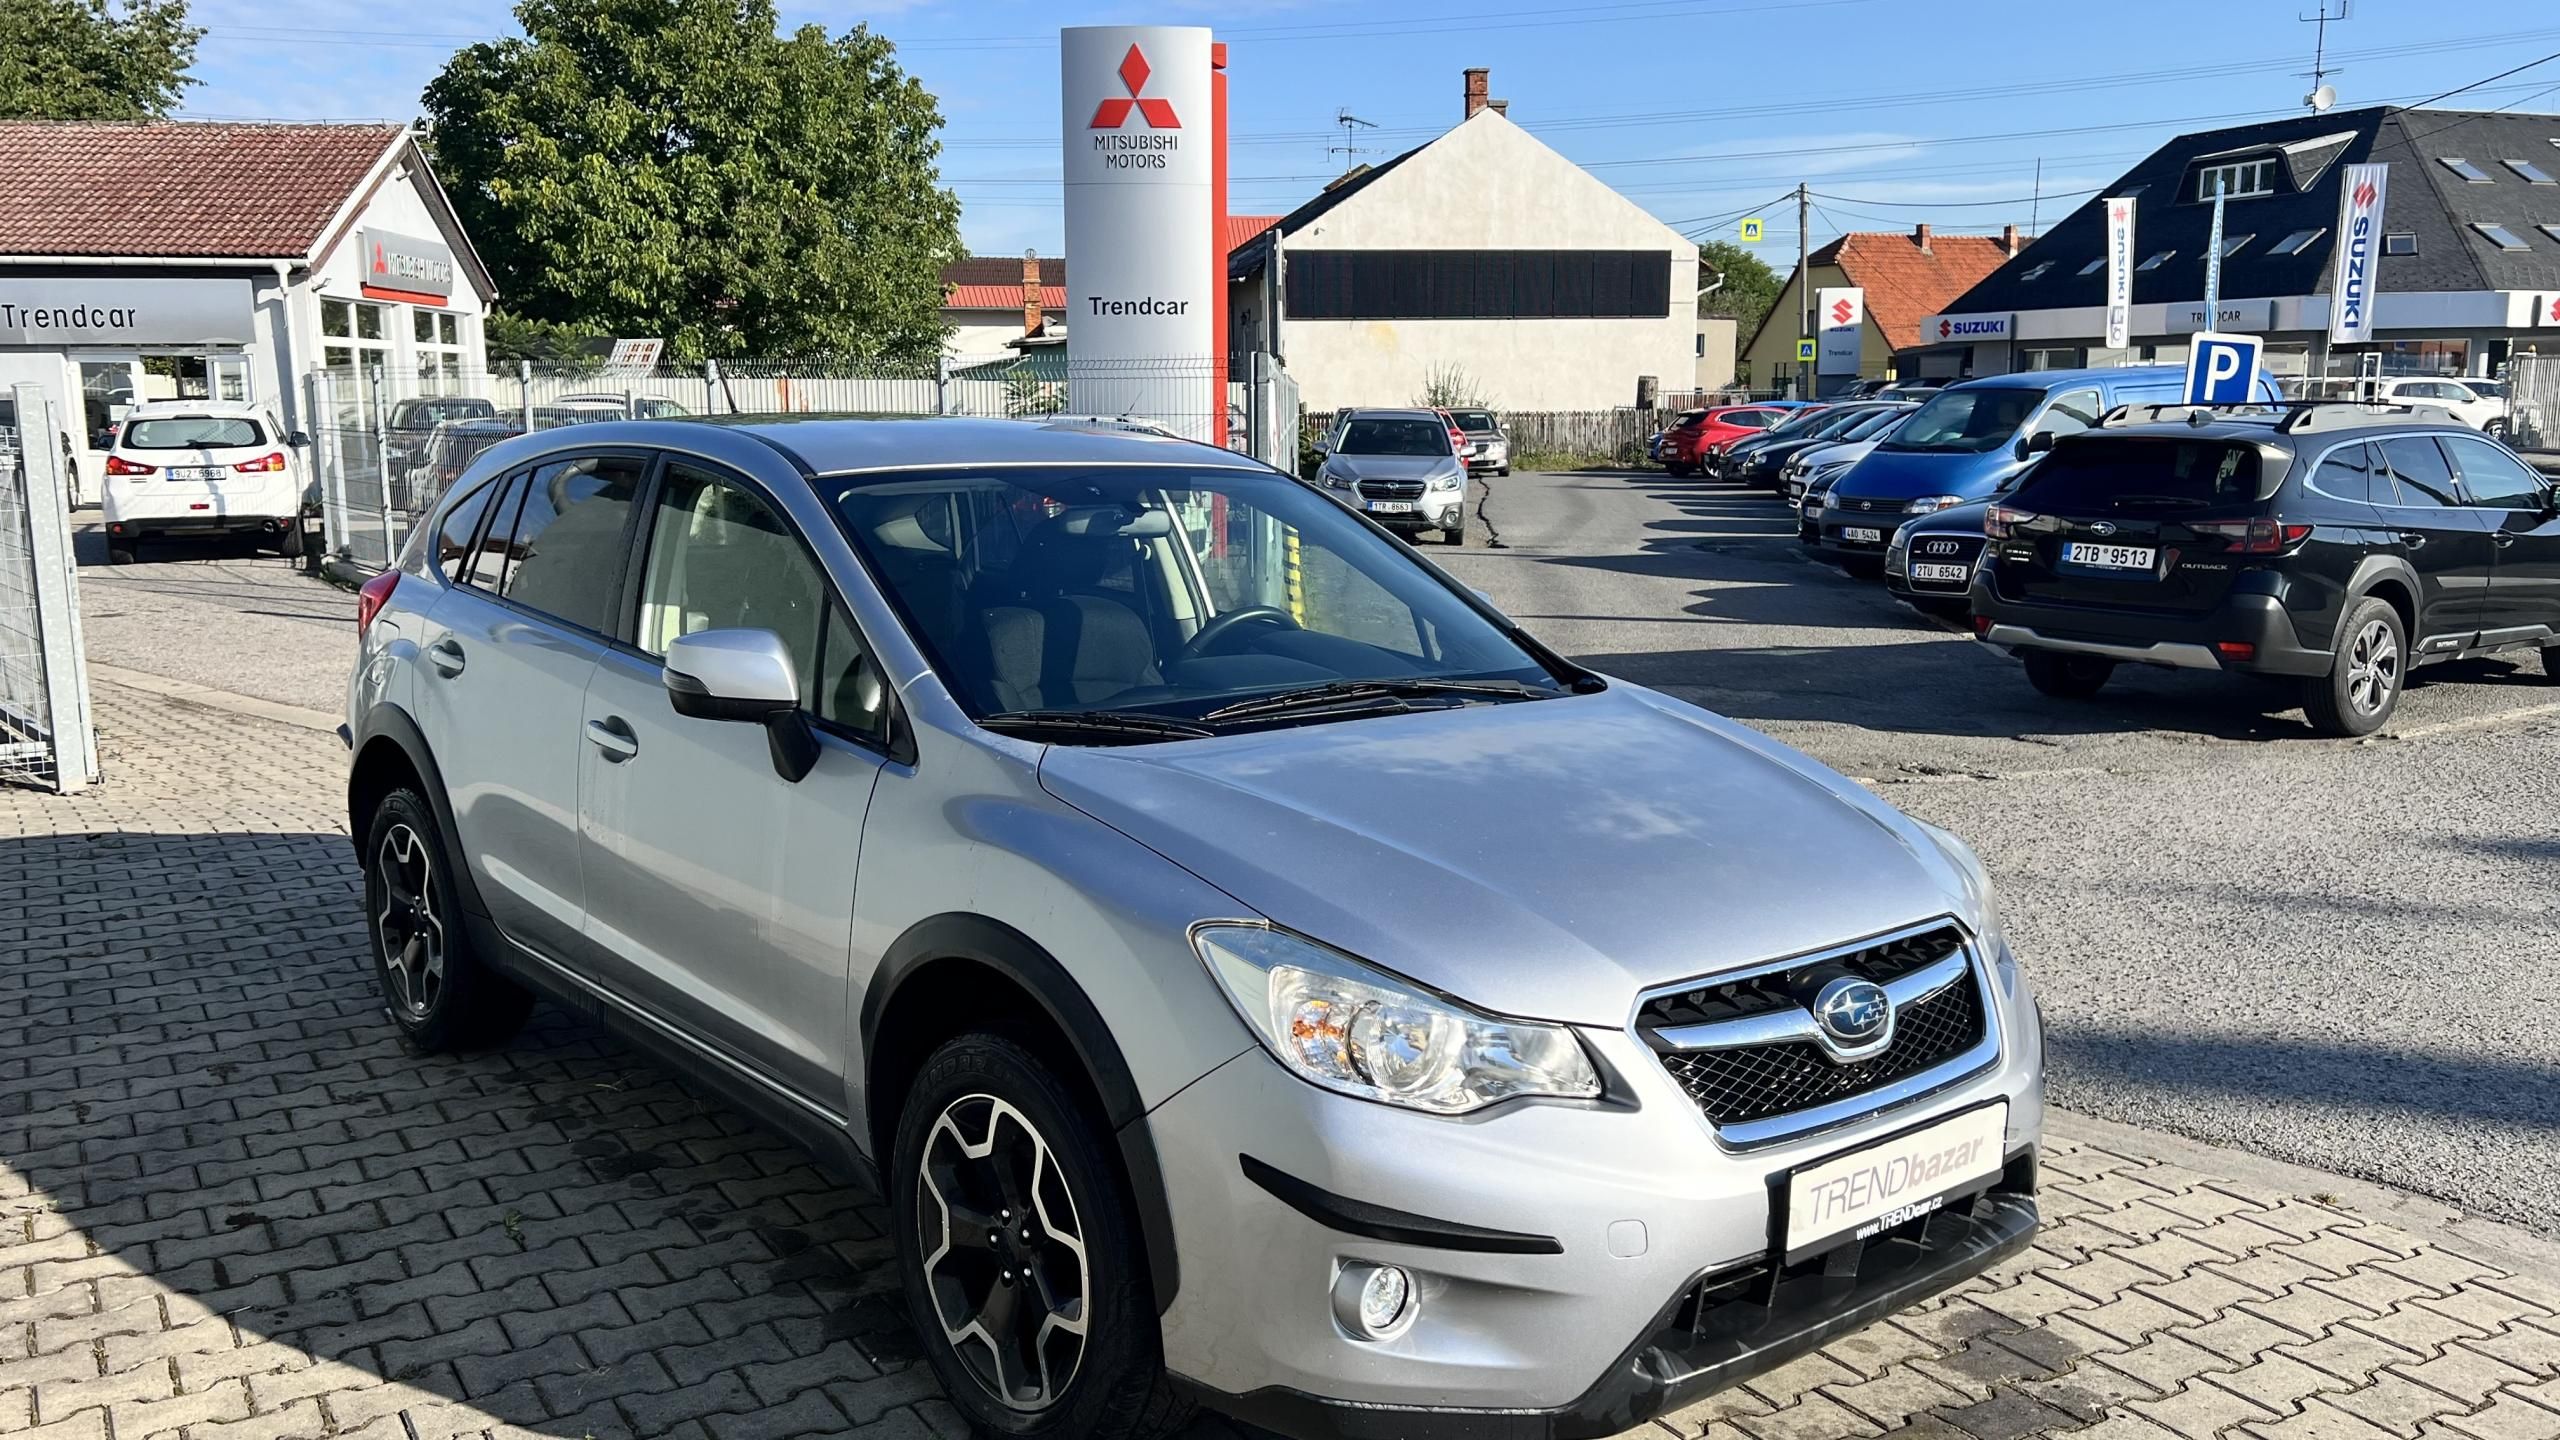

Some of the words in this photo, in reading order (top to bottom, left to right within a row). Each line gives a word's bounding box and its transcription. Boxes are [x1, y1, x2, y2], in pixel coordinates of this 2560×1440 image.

[1095, 135, 1178, 150] MITSUBISHI
[1106, 154, 1166, 168] MOTORS
[2344, 216, 2369, 328] SUZUKI
[1088, 296, 1188, 315] Trendcar
[1, 304, 136, 328] Trendcar
[1953, 320, 2005, 334] SUZUKI
[2204, 345, 2240, 400] P
[2073, 546, 2099, 562] 2TB
[2110, 548, 2148, 566] 9513
[1917, 565, 1933, 577] 2TU
[1939, 566, 1962, 579] 6542
[2181, 562, 2228, 570] OUTBACK
[1810, 1136, 1985, 1225] TRENDbazar
